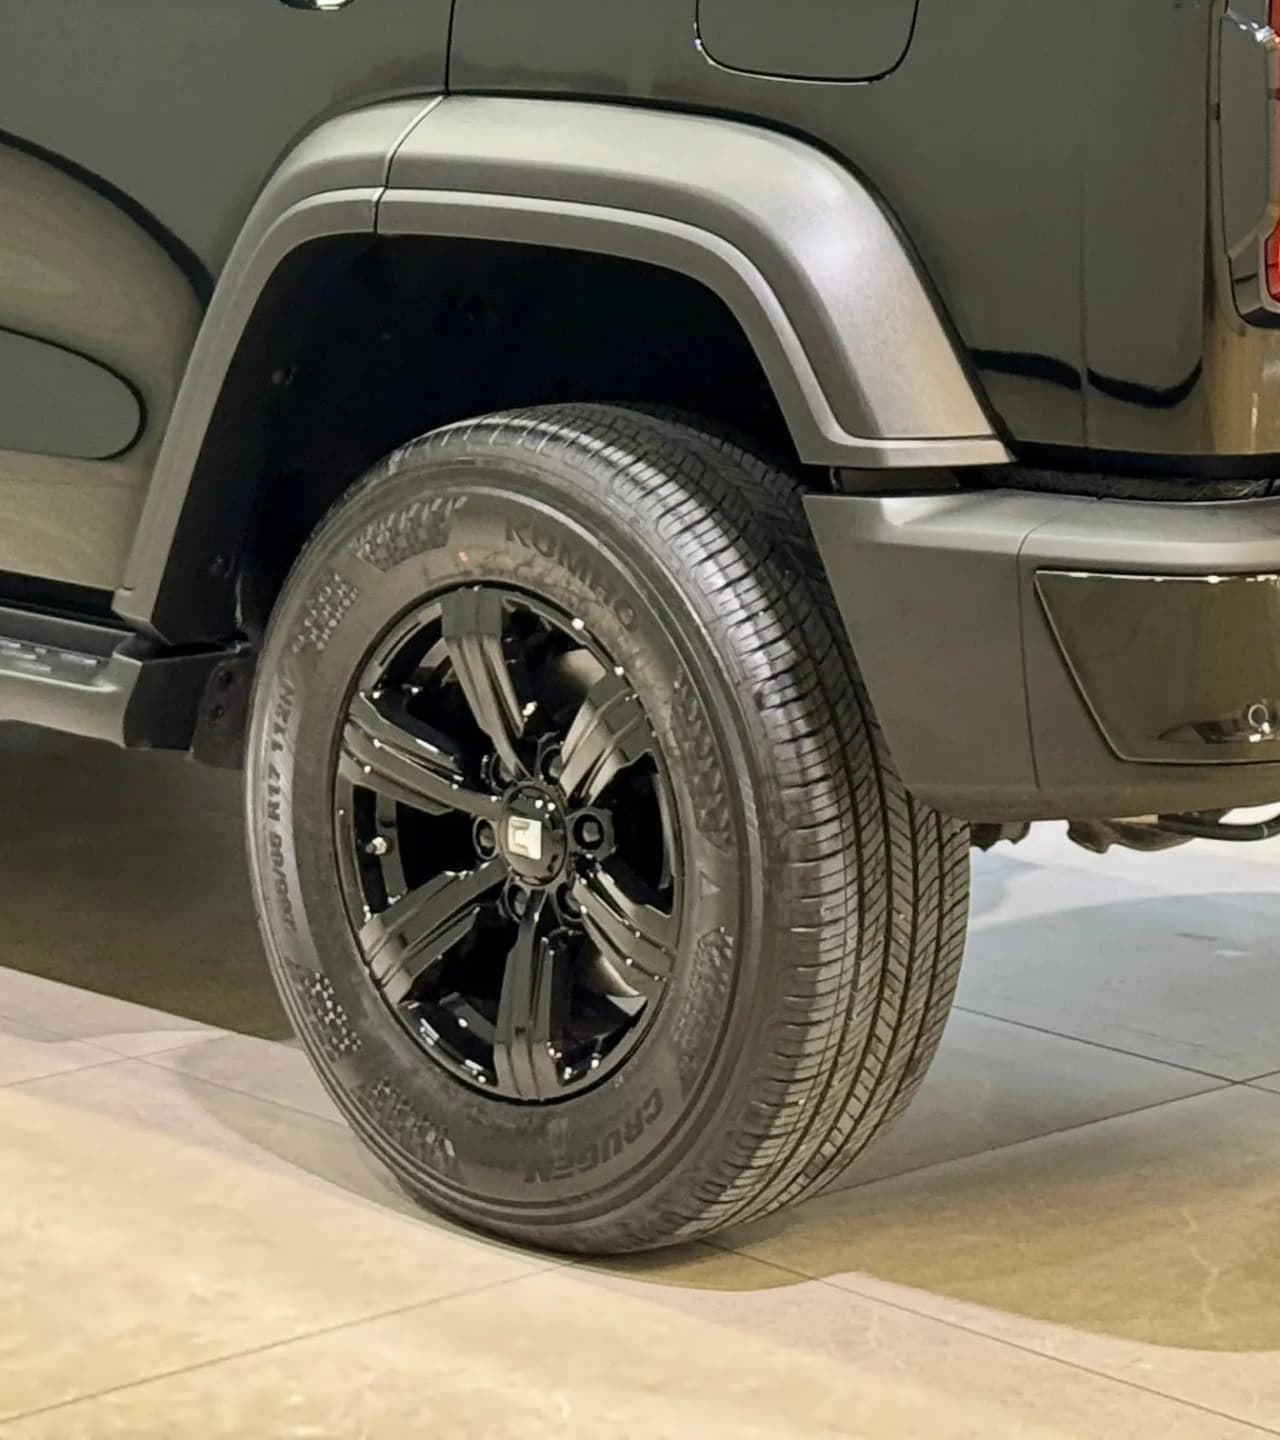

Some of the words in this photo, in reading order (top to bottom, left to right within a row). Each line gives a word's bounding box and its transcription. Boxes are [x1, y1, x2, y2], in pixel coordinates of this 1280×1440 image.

[505, 517, 638, 635] KUMHO
[266, 762, 282, 822] R17
[523, 1086, 664, 1184] CRUGEN
